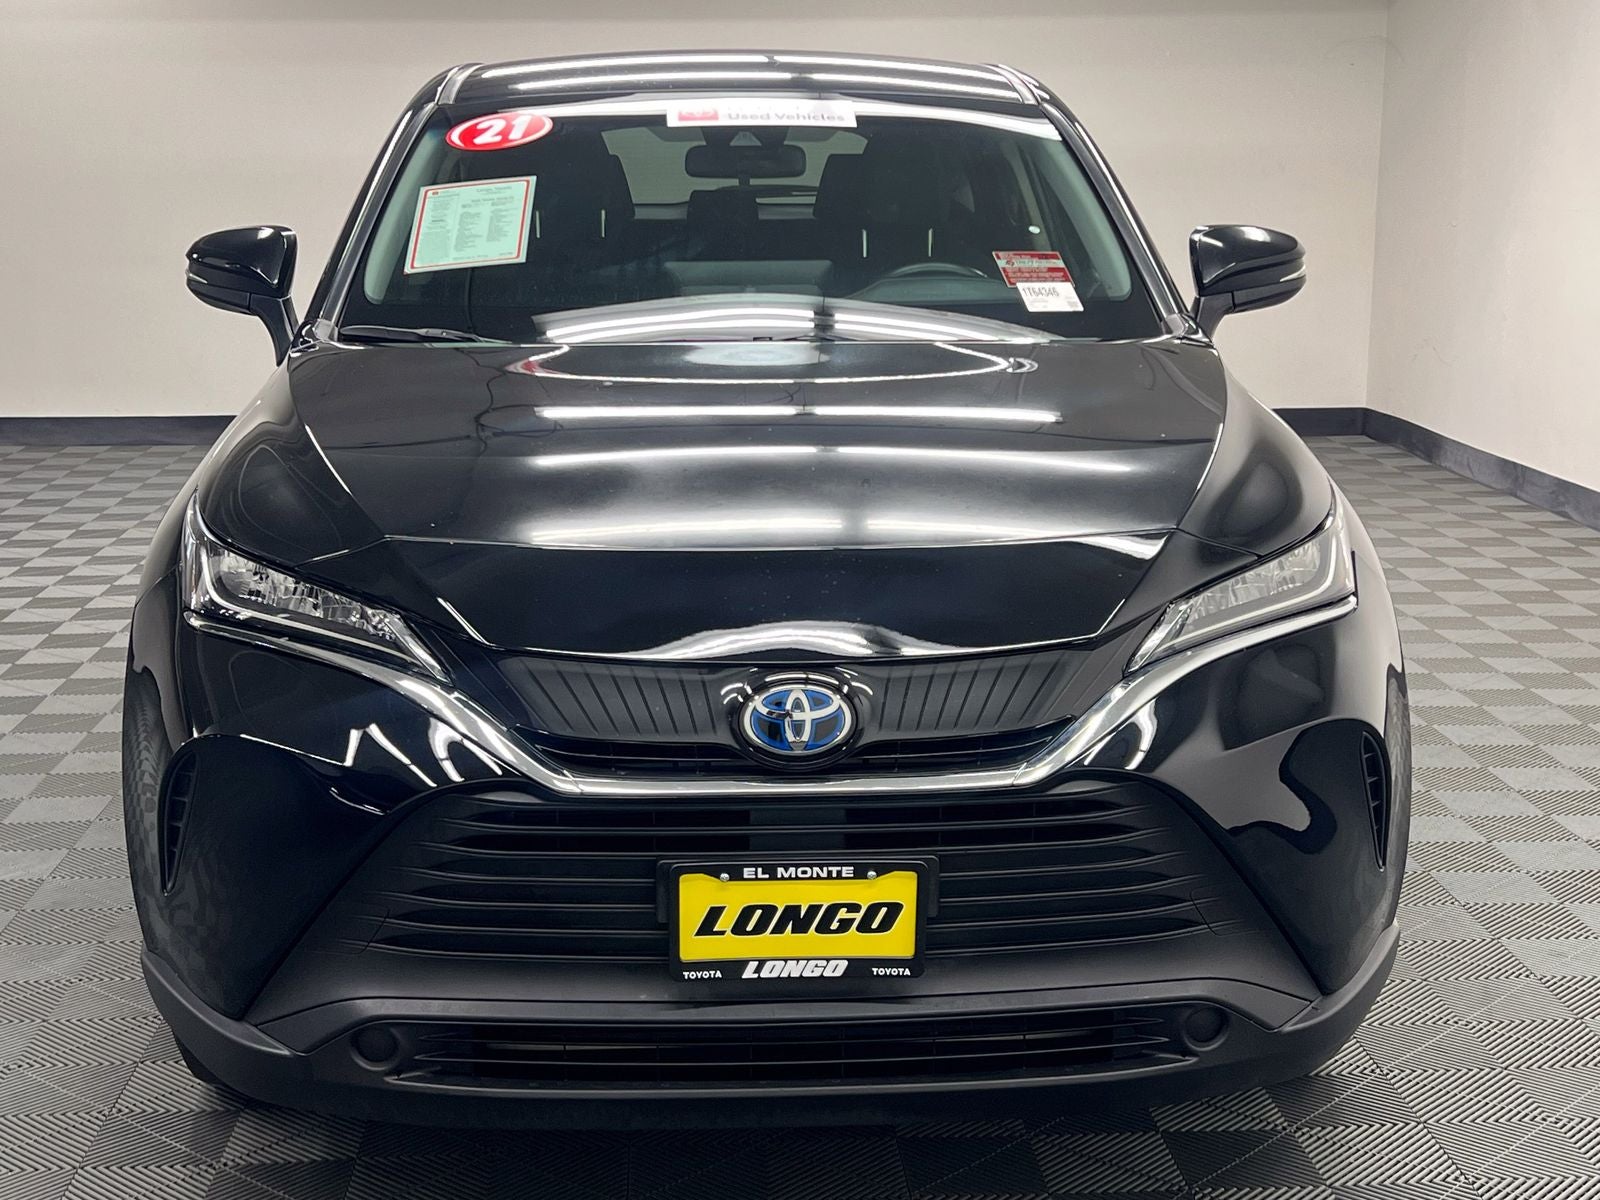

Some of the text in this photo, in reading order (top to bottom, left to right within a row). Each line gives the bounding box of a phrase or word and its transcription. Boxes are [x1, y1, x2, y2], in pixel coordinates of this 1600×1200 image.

[727, 112, 846, 122] Used Vehicles
[472, 115, 532, 145] 21
[743, 866, 855, 879] EL MONTE
[693, 901, 905, 938] LONGO
[682, 970, 722, 980] TOYOTA
[741, 960, 849, 979] LONGO
[871, 967, 911, 977] TOYOTA
